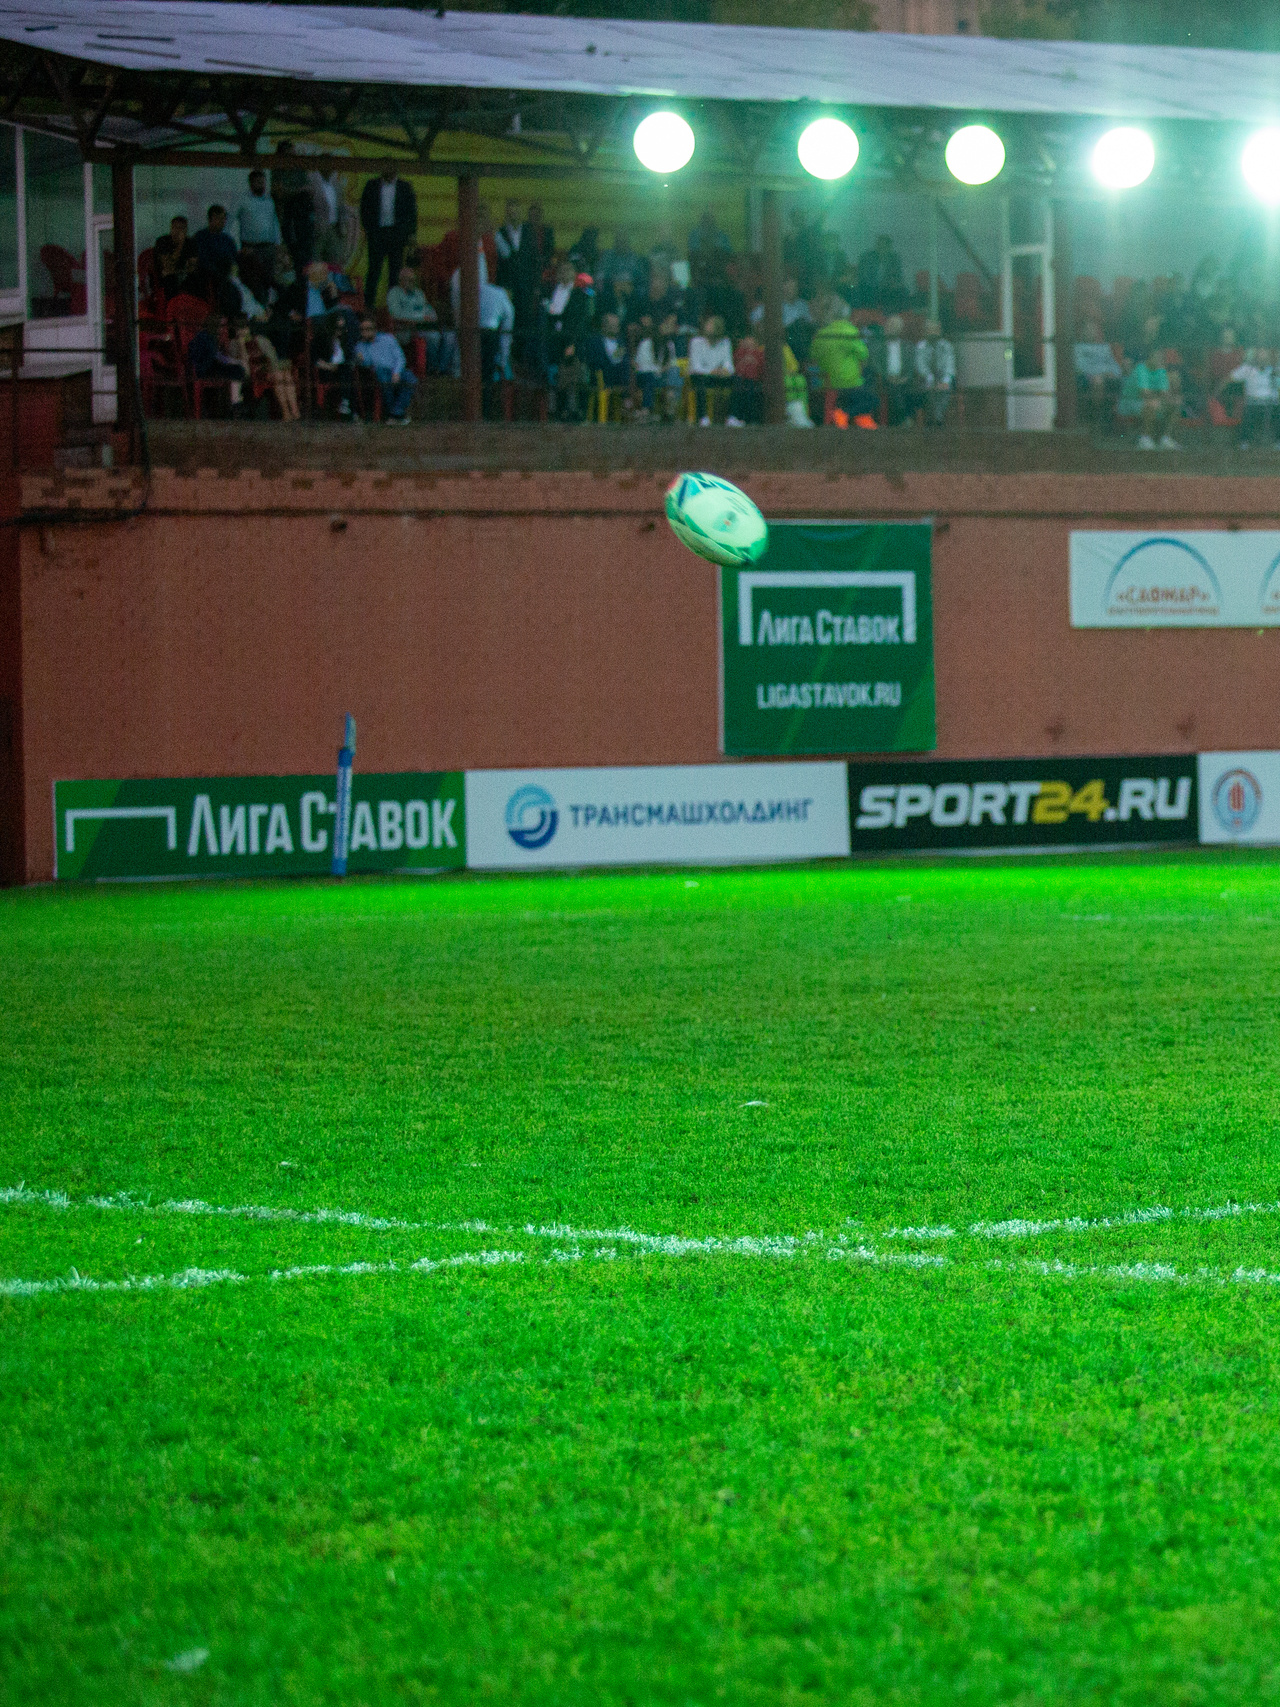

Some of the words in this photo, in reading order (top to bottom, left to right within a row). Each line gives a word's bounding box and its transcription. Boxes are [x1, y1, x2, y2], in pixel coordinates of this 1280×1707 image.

[756, 682, 901, 709] LIGASTAVOK.RU
[570, 798, 813, 828] ТРАНСМАШХОЛДИНГ
[855, 776, 1192, 829] SPORT24.RU
